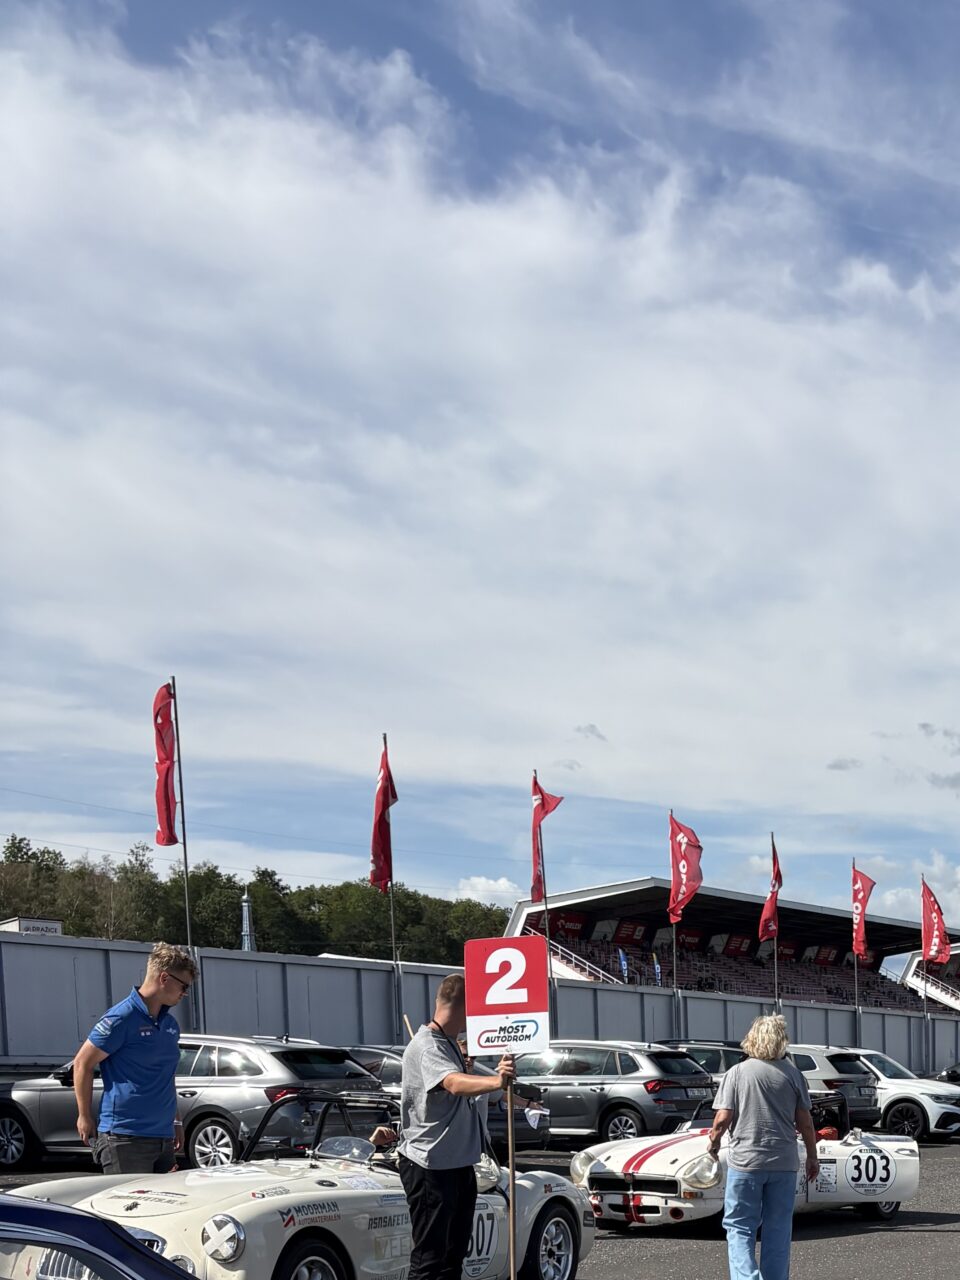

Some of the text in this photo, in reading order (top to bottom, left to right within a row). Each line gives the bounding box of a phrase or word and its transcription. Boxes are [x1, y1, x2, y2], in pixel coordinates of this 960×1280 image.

[485, 947, 529, 1006] 2
[498, 1025, 527, 1035] MOST
[484, 1034, 532, 1044] AUTODROM
[850, 1154, 891, 1183] 303
[293, 1201, 340, 1217] MOORMAN
